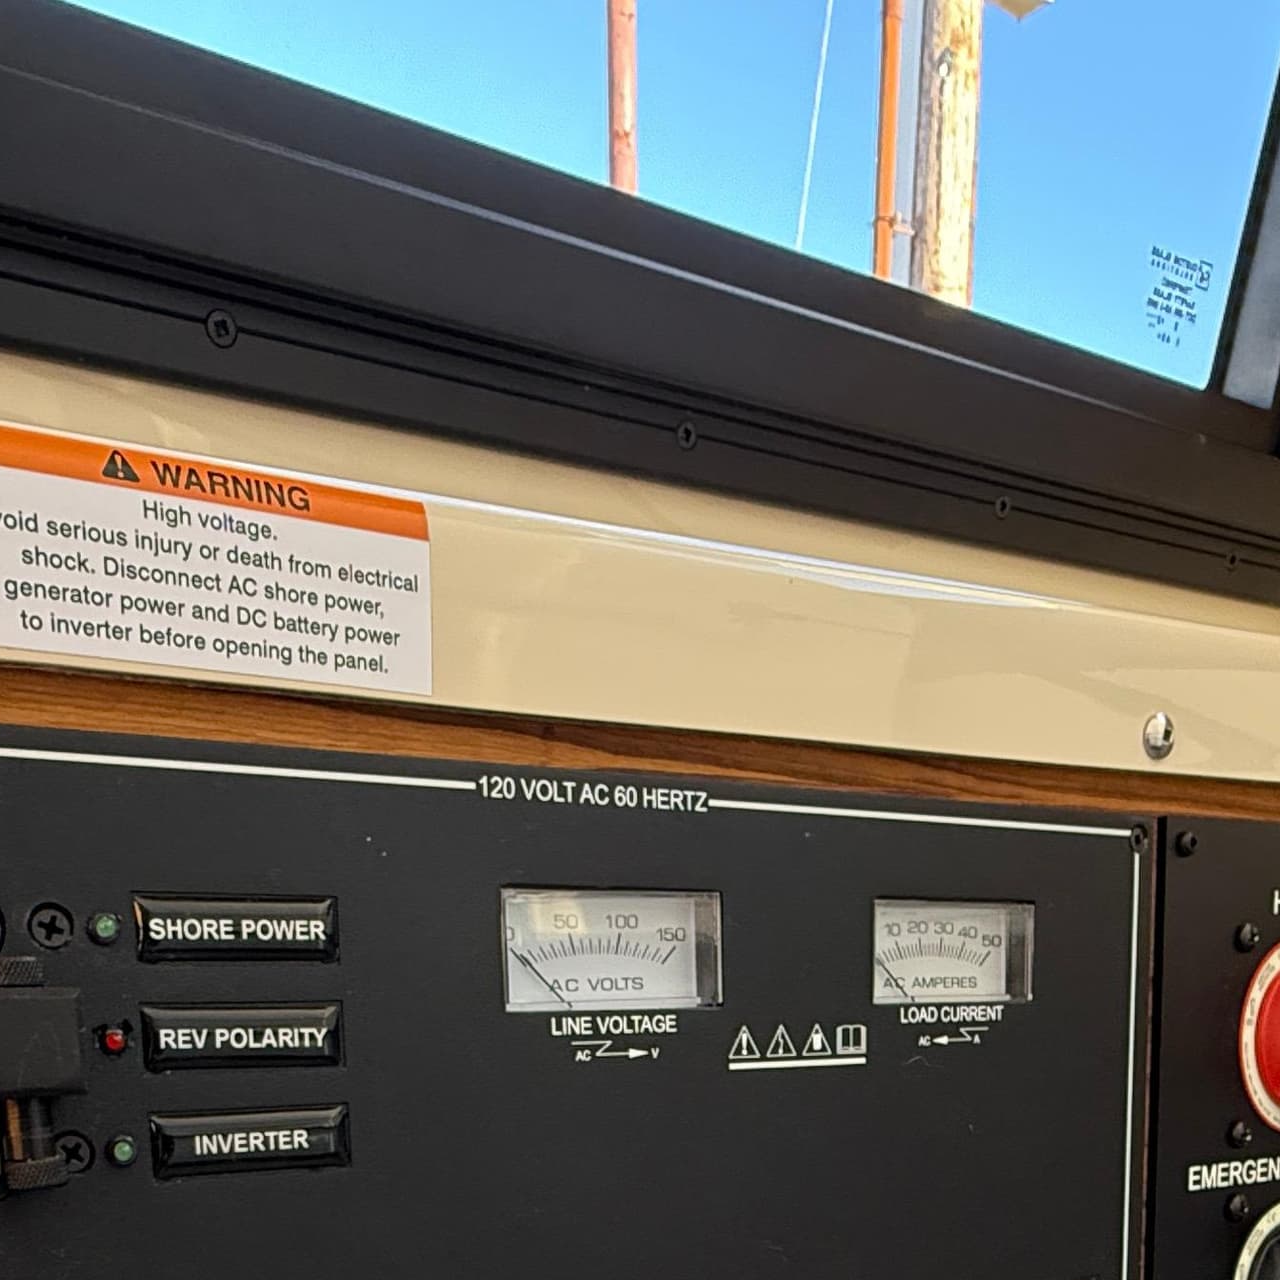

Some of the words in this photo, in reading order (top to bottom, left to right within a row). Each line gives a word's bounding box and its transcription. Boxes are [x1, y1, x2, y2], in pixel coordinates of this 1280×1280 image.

[150, 461, 310, 512] WARNING
[143, 499, 191, 528] High
[198, 512, 278, 541] voltage.
[47, 520, 127, 547] serious
[135, 530, 192, 561] injury
[200, 544, 219, 560] or
[227, 546, 282, 571] death
[288, 555, 332, 580] from
[338, 564, 418, 593] electrical
[22, 546, 96, 574] shock.
[104, 556, 221, 592] Disconnect
[228, 575, 257, 597] AC
[264, 582, 318, 606] shore
[325, 593, 385, 619] power,
[4, 578, 113, 608] generator
[120, 594, 185, 617] power
[192, 603, 229, 623] and
[237, 606, 267, 628] DC
[274, 611, 338, 642] battery
[345, 625, 400, 647] power
[20, 610, 42, 631] to
[50, 612, 132, 641] inverter
[140, 623, 205, 650] before
[213, 637, 292, 666] opening
[299, 645, 327, 665] the
[335, 653, 388, 673] panel.
[478, 775, 516, 800] 120
[521, 778, 576, 803] VOLT
[579, 782, 609, 806] AC
[614, 785, 637, 808] 60
[642, 788, 709, 812] HERTZ
[149, 918, 235, 941] SHORE
[241, 918, 326, 941] POWER
[553, 914, 578, 929] 50
[606, 914, 638, 929] 100
[657, 928, 686, 942] 150
[885, 923, 901, 936] 10
[907, 921, 928, 934] 20
[934, 922, 954, 935] 30
[958, 926, 977, 939] 40
[982, 935, 1002, 948] 50
[550, 979, 579, 993] AC
[587, 977, 644, 992] VOLTS
[883, 977, 905, 989] AC
[912, 976, 977, 989] AMPERES
[551, 1016, 593, 1036] LINE
[596, 1015, 677, 1034] VOLTAGE
[900, 1007, 938, 1023] LOAD
[940, 1005, 1003, 1022] CURRENT
[160, 1029, 208, 1050] REV
[215, 1027, 328, 1049] POLARITY
[918, 1036, 931, 1046] AC
[576, 1050, 591, 1062] AC
[194, 1130, 309, 1156] INVERTER
